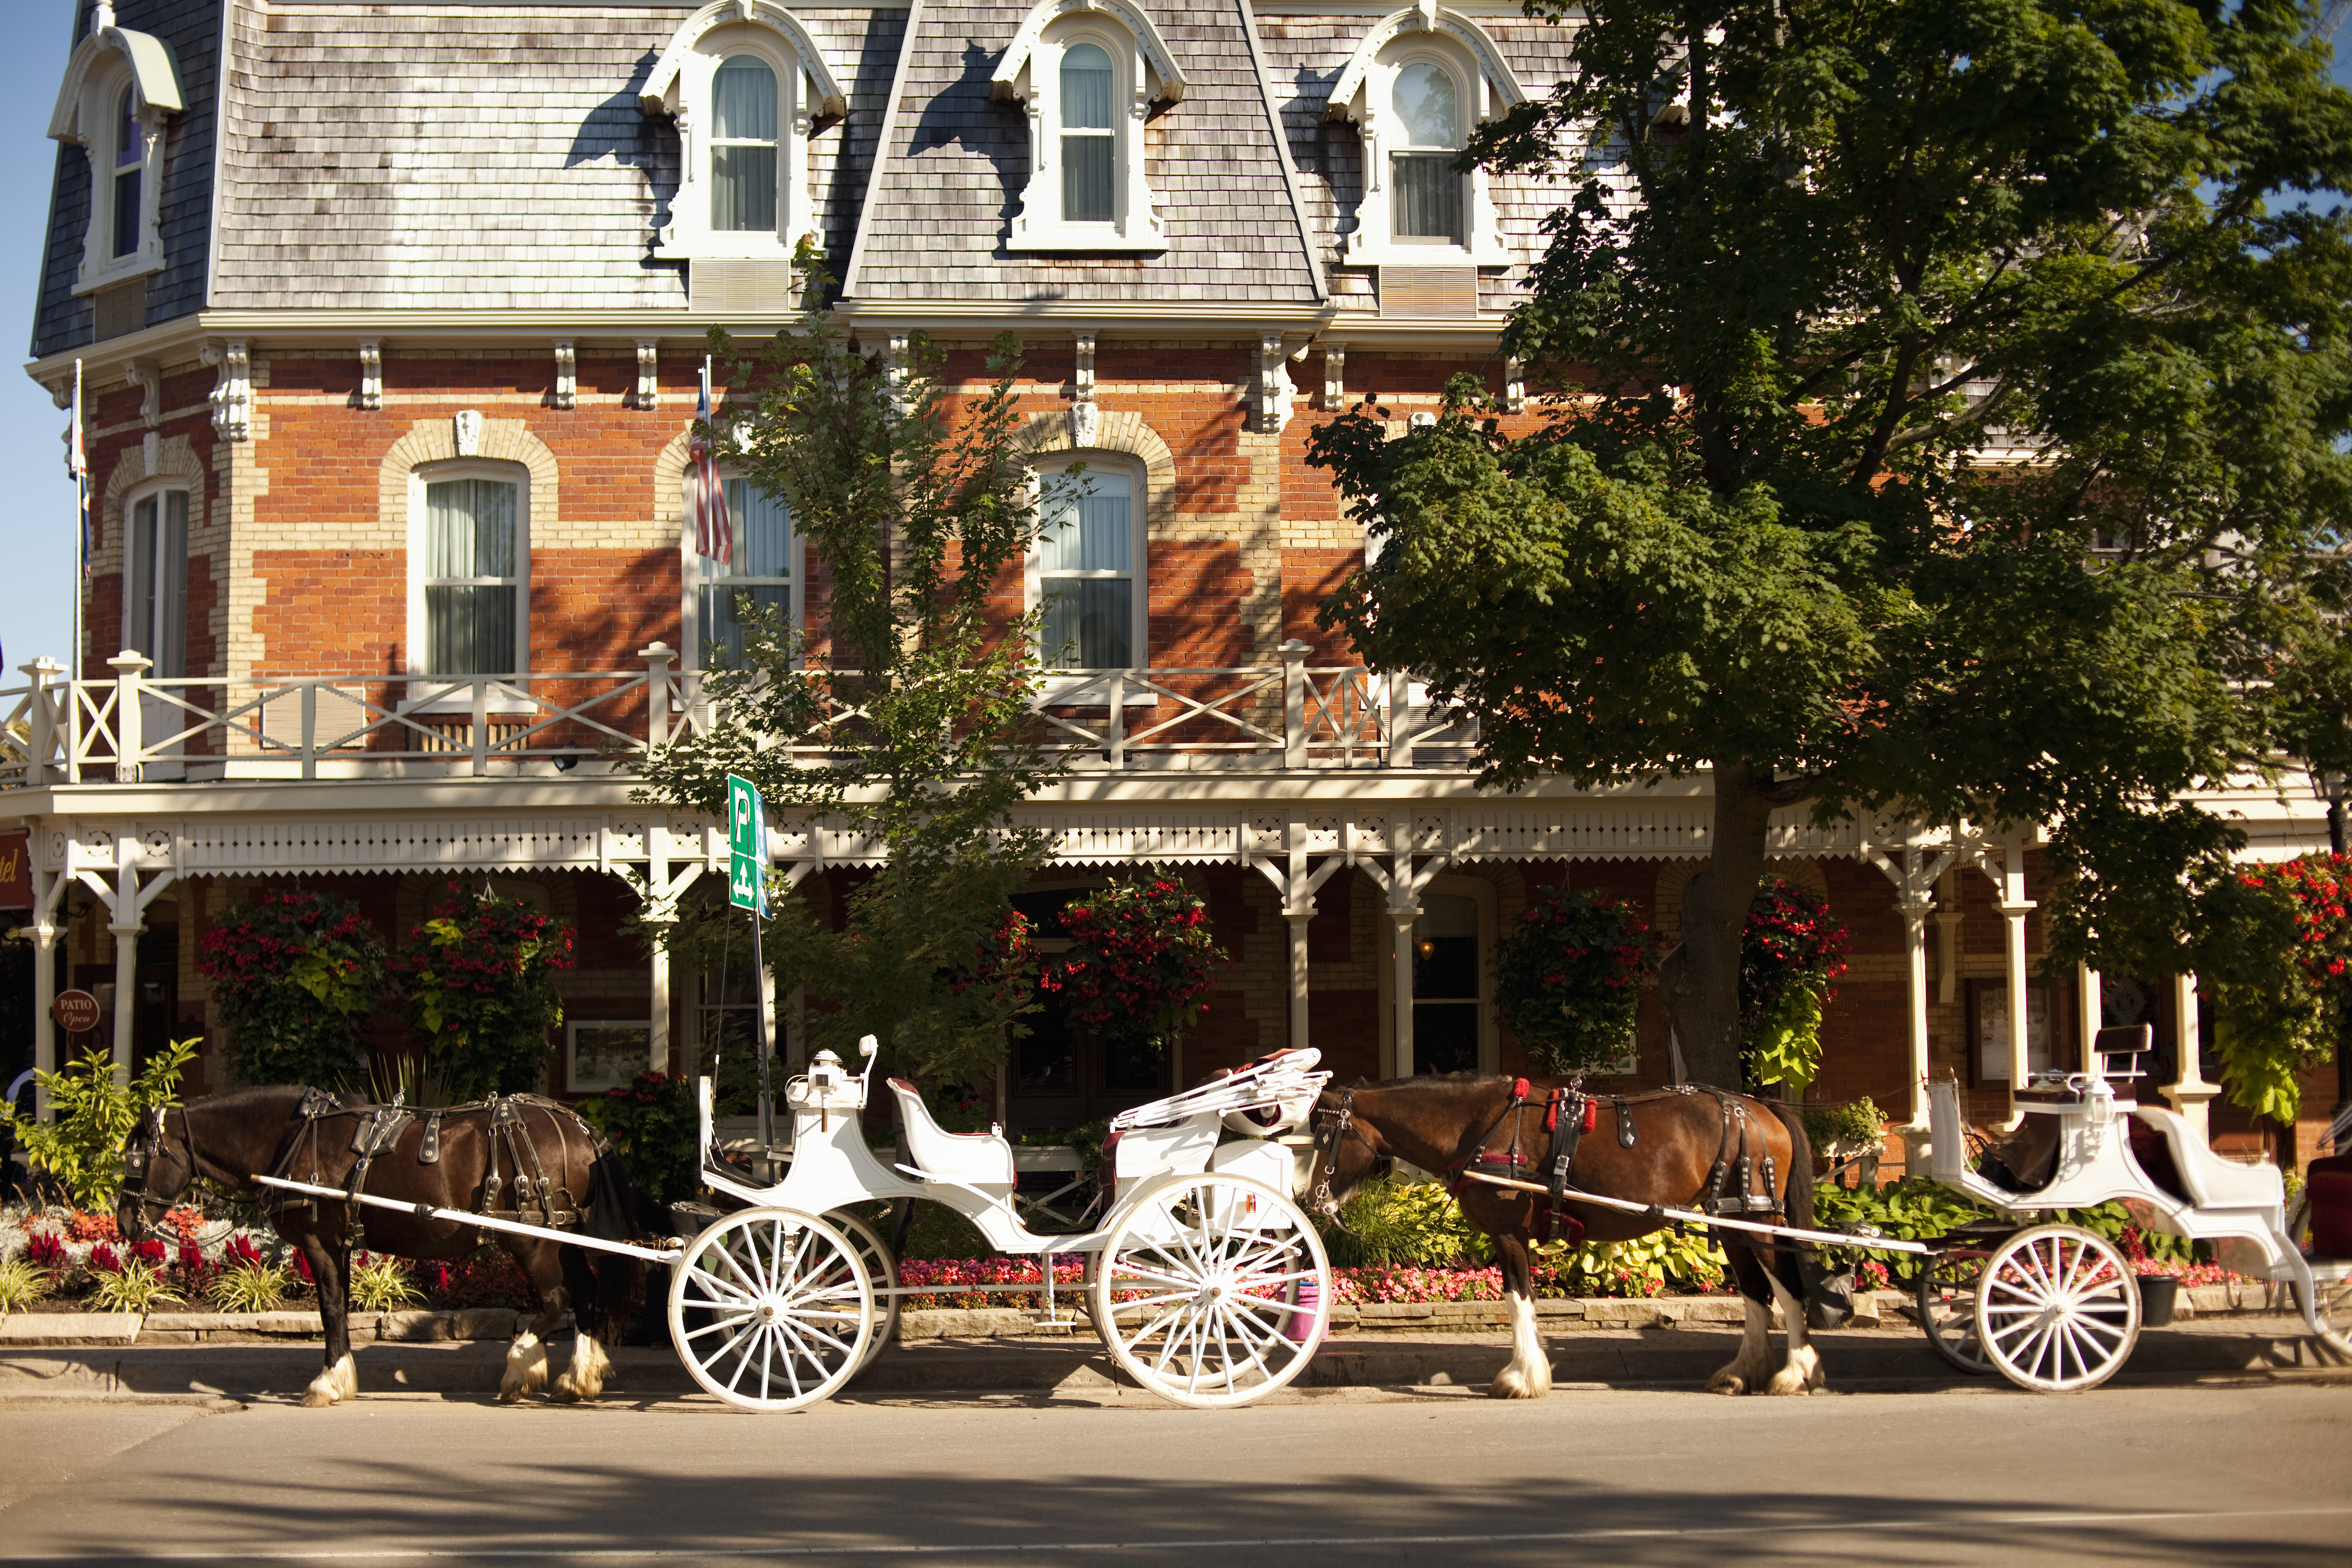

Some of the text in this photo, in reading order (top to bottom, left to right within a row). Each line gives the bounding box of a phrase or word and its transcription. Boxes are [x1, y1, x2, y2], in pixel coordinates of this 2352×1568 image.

[735, 786, 750, 843] P
[60, 1000, 92, 1010] PATIO
[63, 1012, 90, 1027] Open
